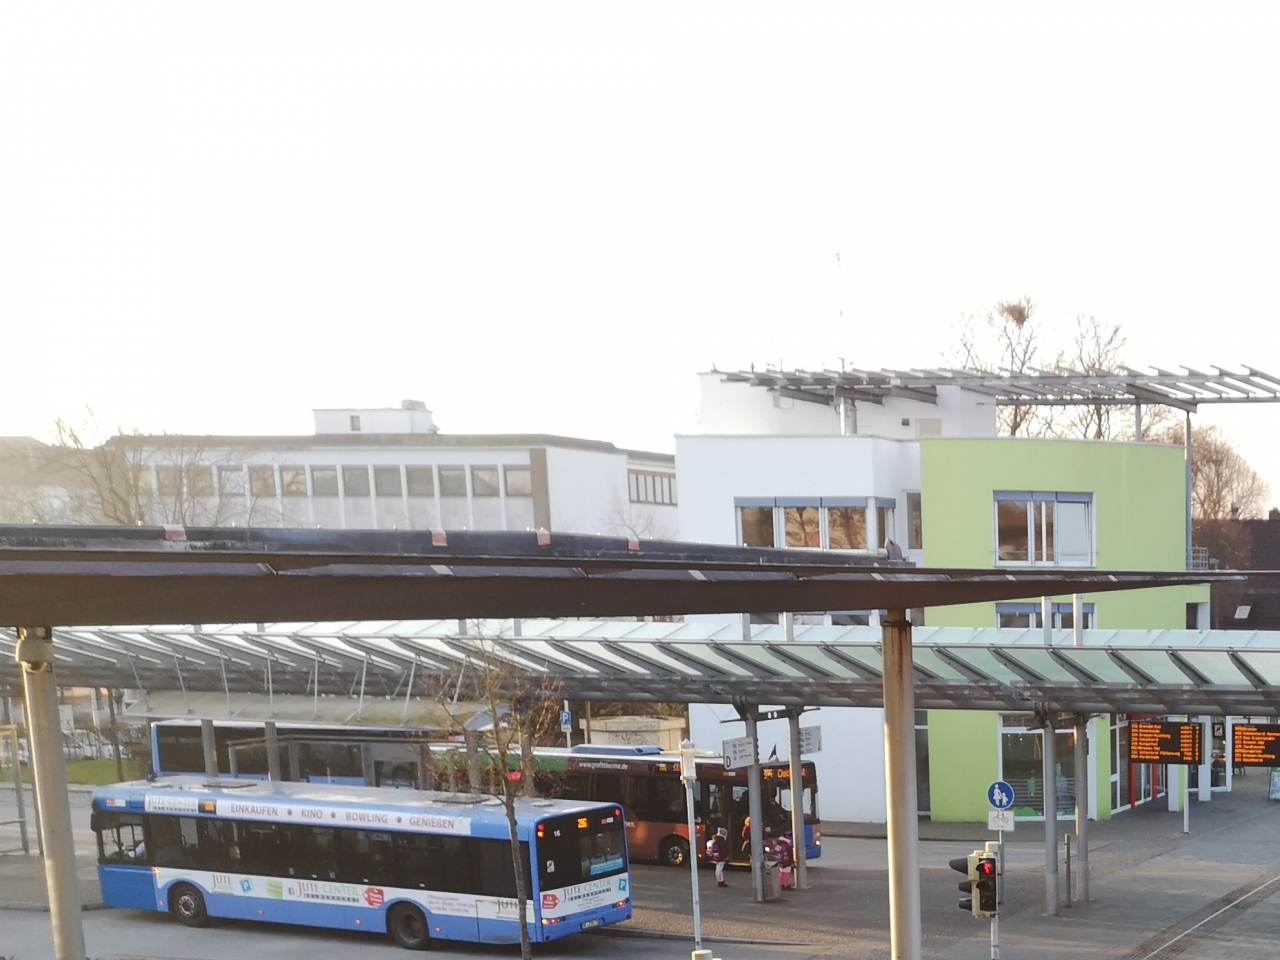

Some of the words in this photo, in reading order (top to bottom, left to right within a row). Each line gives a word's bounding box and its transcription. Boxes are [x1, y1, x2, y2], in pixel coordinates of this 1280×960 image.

[726, 756, 732, 768] D
[230, 803, 278, 816] EINKAUFEN
[301, 808, 323, 819] KINO
[345, 811, 388, 823] BOWLING
[553, 829, 561, 837] 16
[211, 874, 232, 891] JUTE
[297, 881, 319, 898] JUTE
[322, 883, 360, 897] CENTER
[562, 884, 582, 902] JUTE
[584, 880, 612, 893] CENTER
